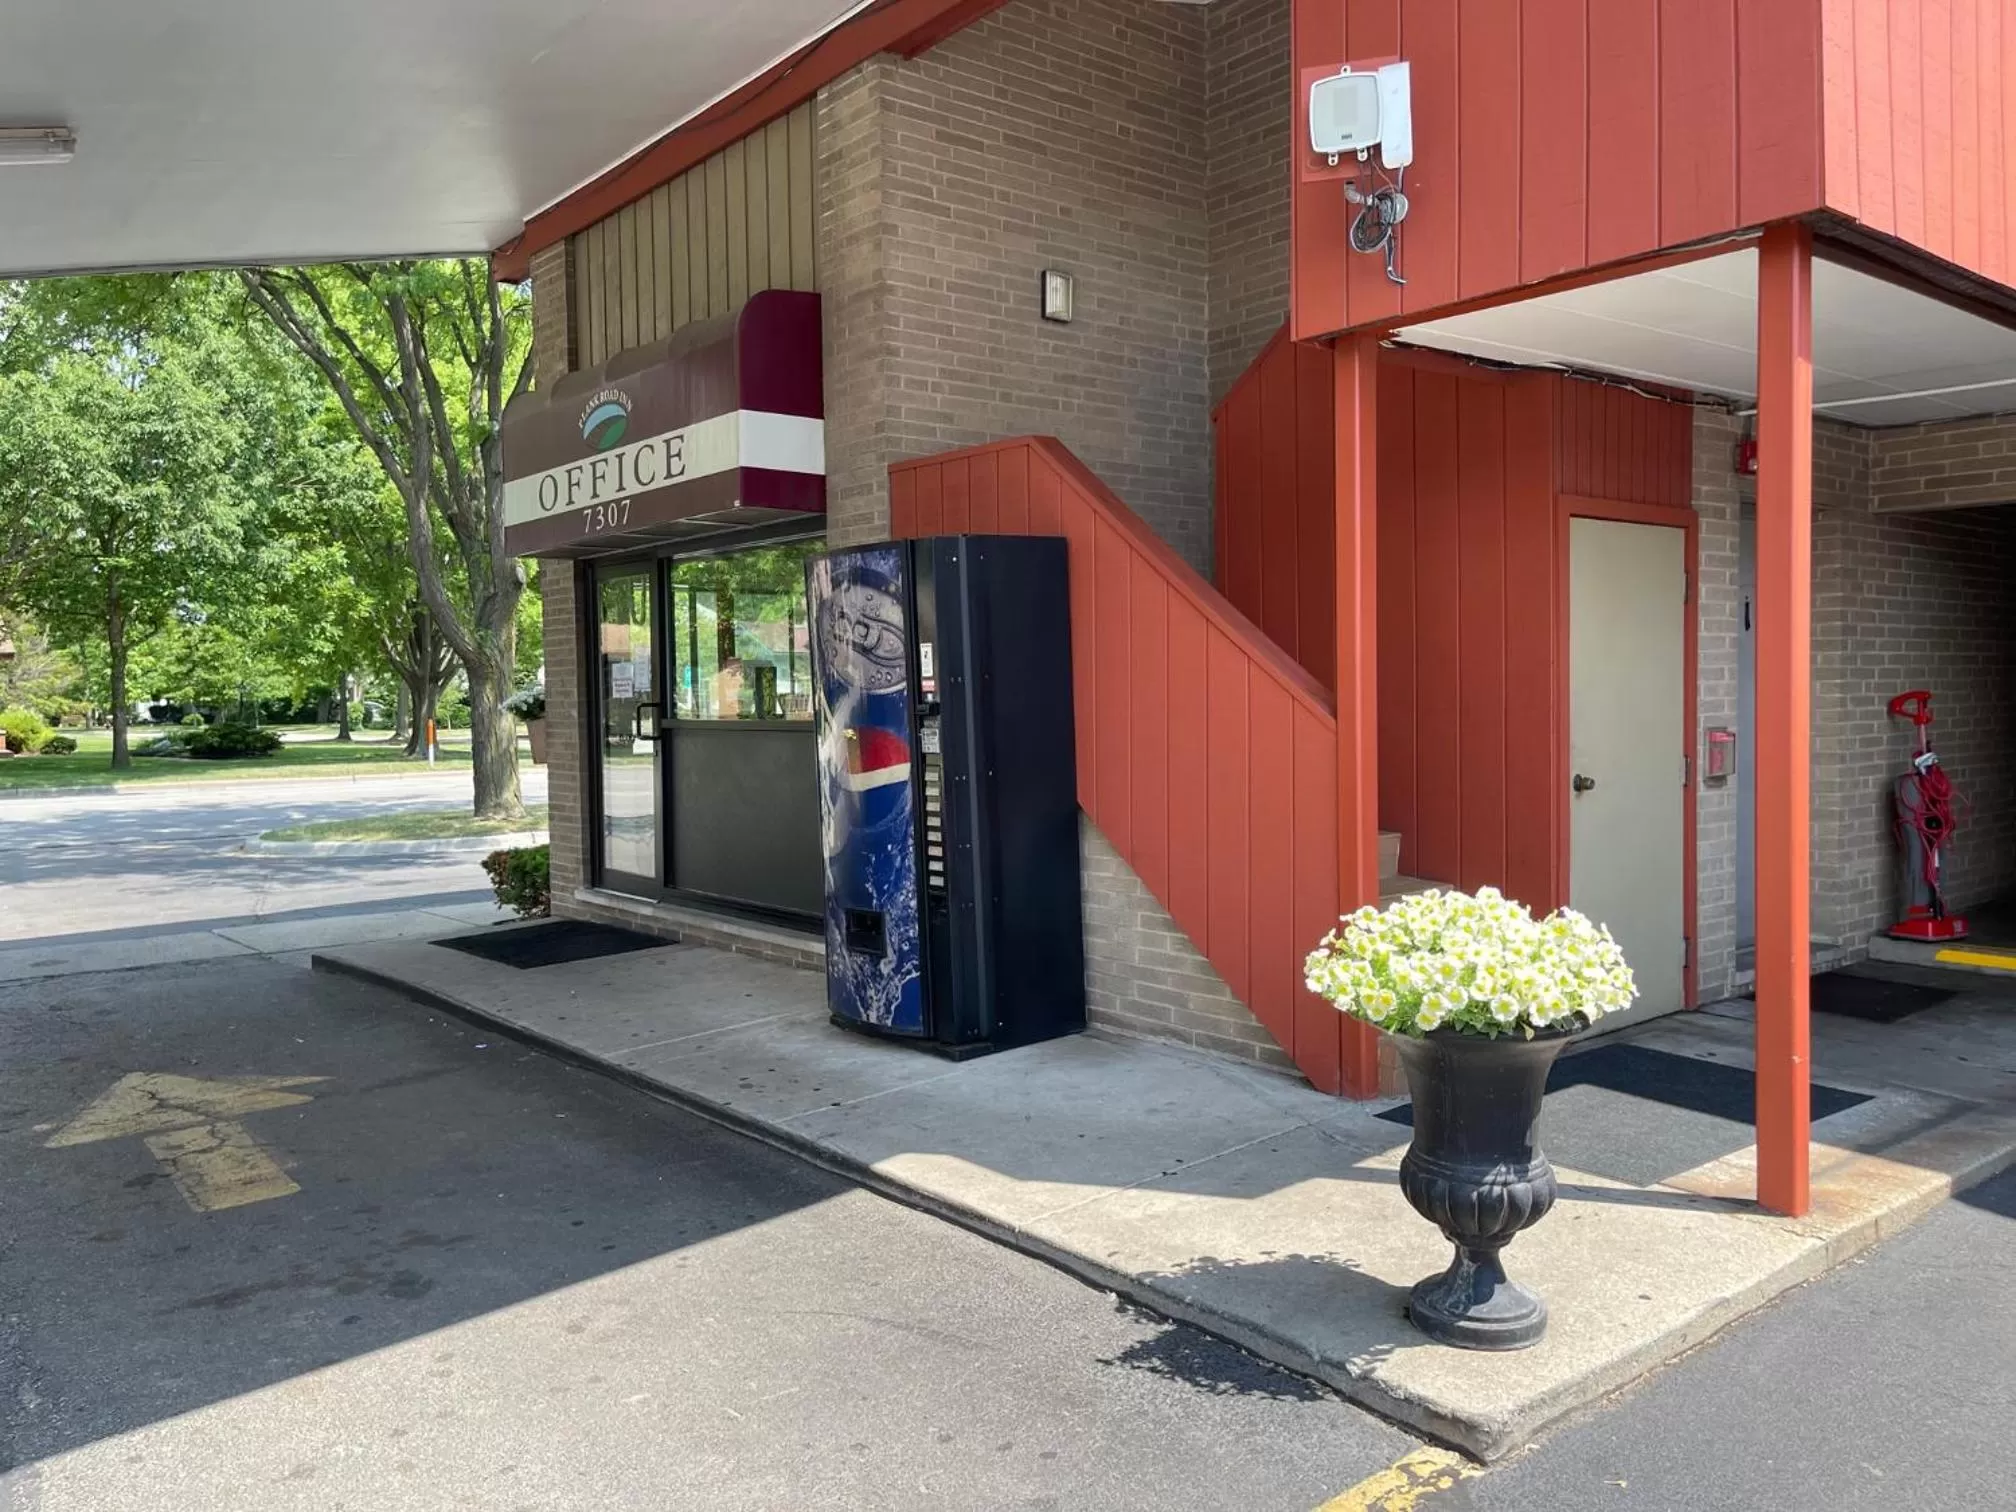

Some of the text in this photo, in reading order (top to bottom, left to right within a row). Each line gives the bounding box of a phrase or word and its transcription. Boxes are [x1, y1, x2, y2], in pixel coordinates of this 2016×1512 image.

[600, 388, 619, 403] ROAD
[538, 435, 686, 512] OFFICE
[583, 499, 632, 534] 7307
